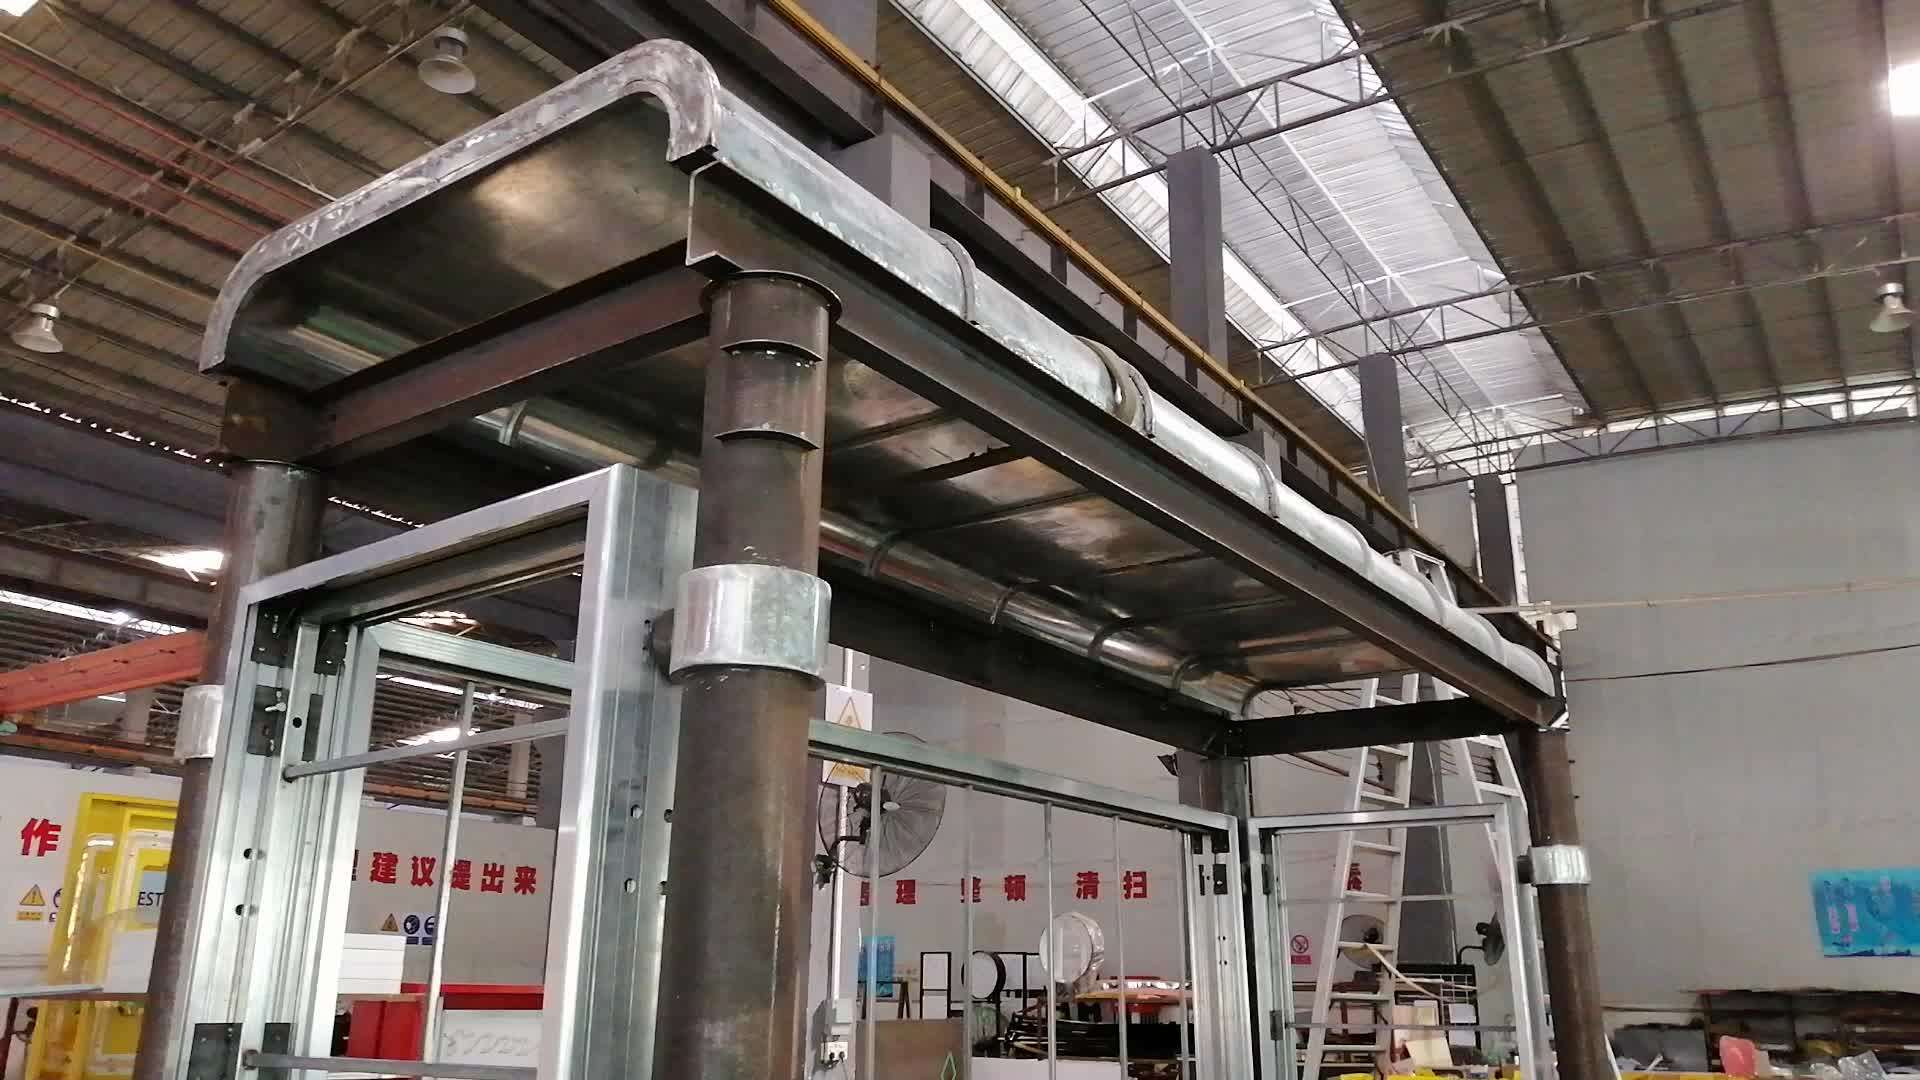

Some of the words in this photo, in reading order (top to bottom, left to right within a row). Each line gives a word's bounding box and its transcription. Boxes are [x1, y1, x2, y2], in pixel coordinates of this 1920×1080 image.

[20, 817, 62, 857] 作
[352, 850, 537, 894] 建议提出来
[1076, 870, 1148, 899] 清扫
